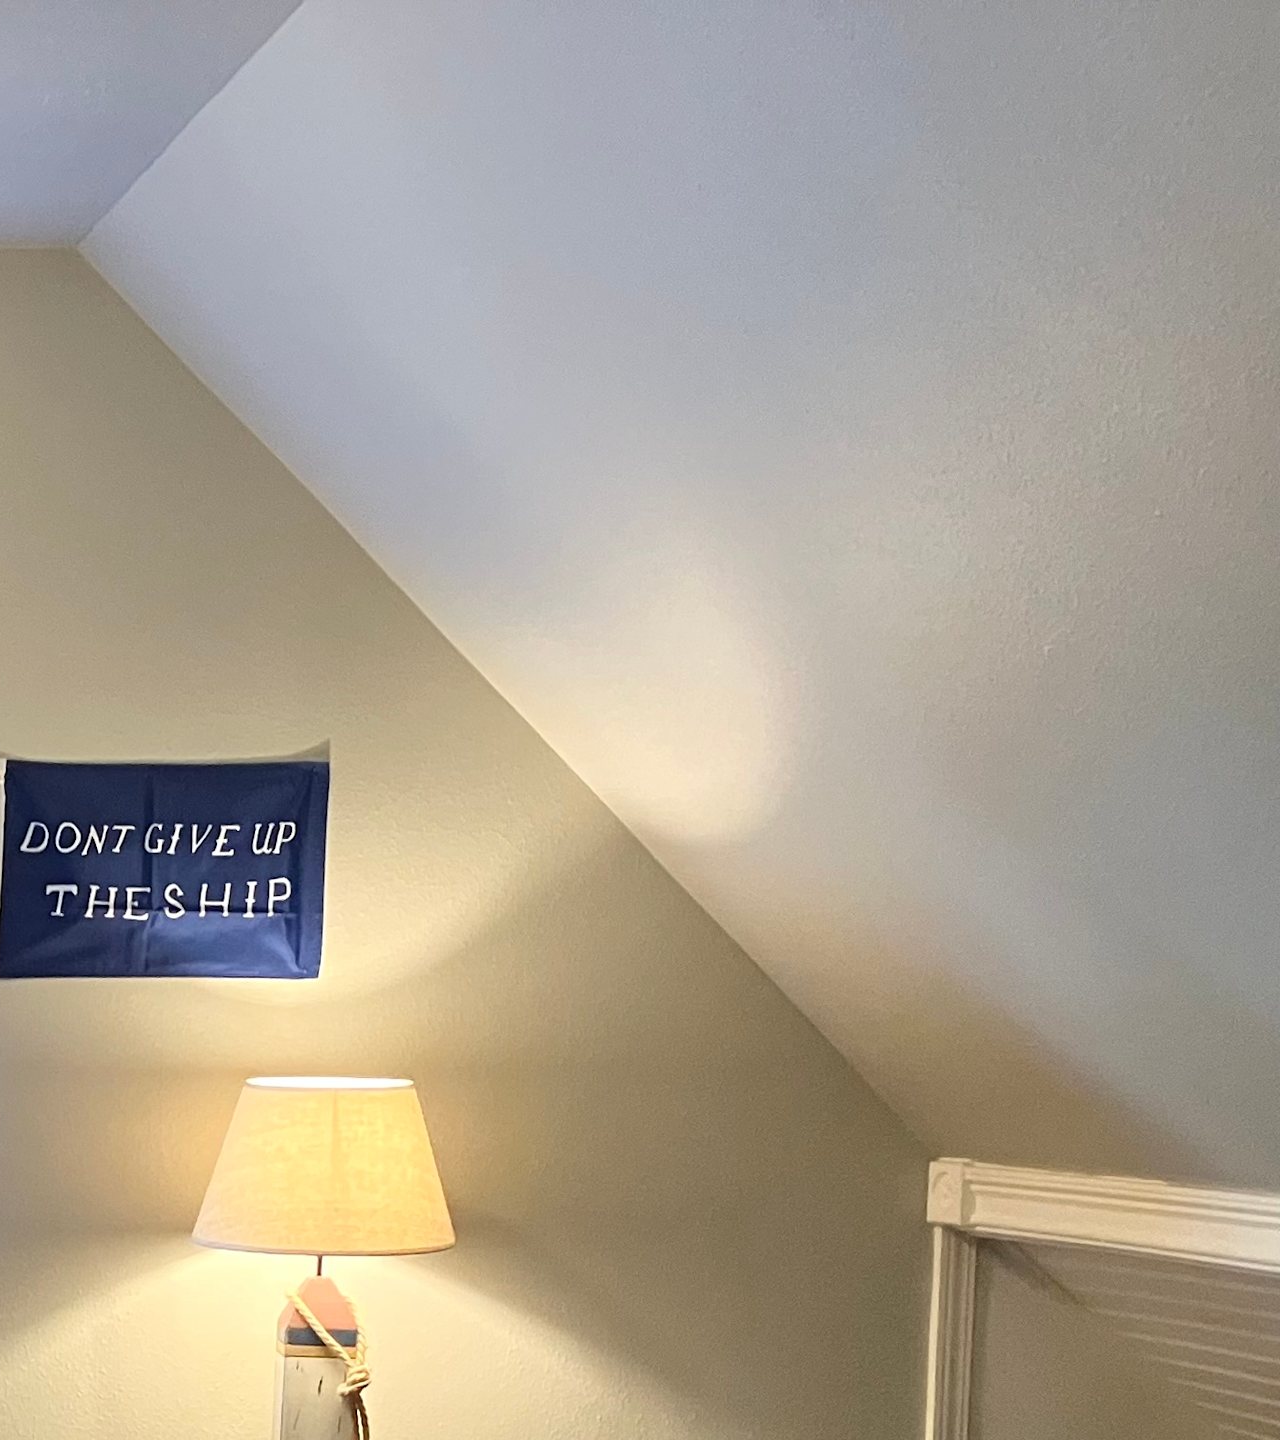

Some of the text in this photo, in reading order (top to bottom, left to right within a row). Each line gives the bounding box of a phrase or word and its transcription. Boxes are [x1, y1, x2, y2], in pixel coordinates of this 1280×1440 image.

[20, 821, 297, 856] DONT GIVE UP
[45, 876, 292, 921] THE SHIP
